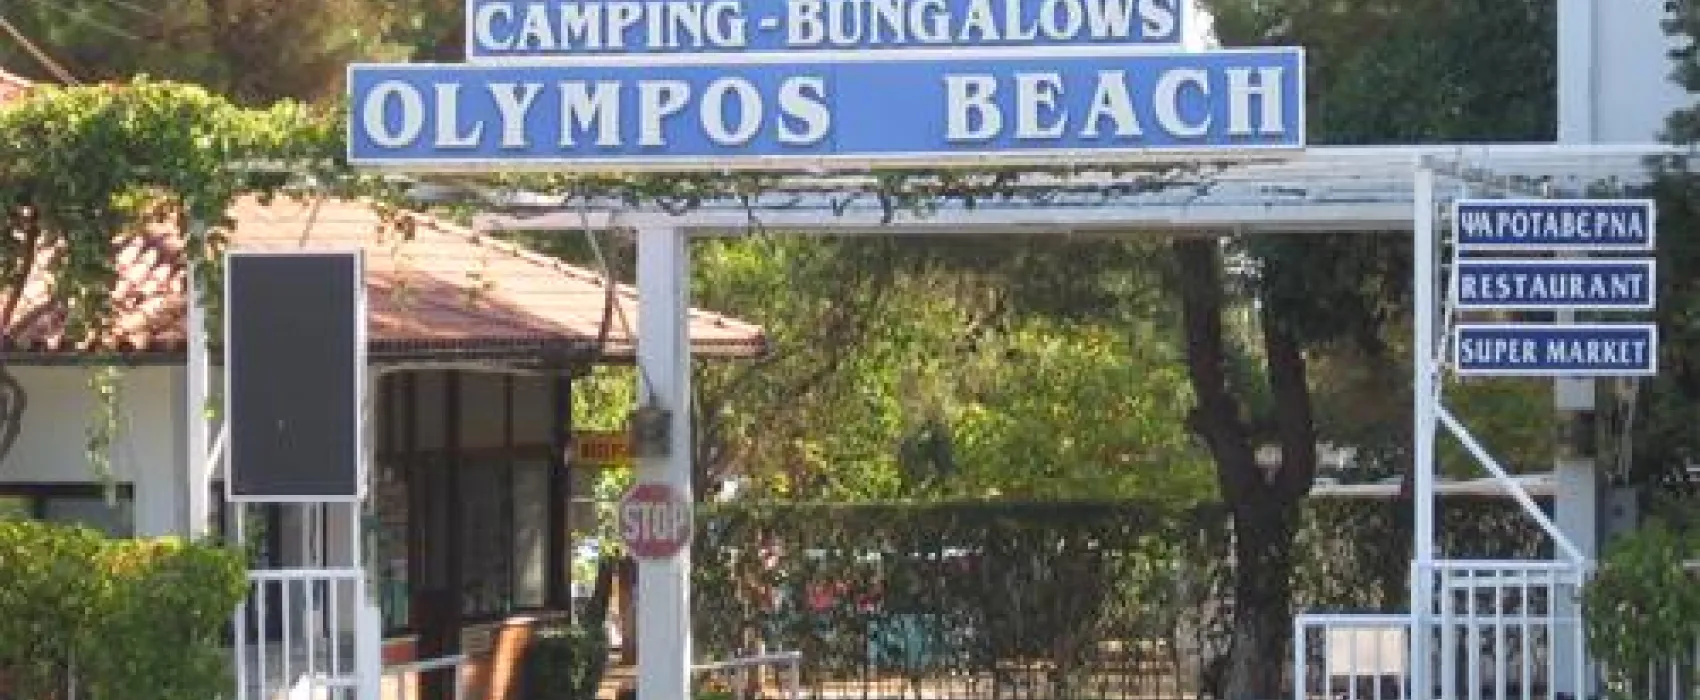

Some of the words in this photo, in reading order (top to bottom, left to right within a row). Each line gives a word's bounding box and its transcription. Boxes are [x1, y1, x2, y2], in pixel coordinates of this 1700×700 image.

[475, 1, 747, 51] CAMPING
[362, 76, 832, 149] OLYMPOS
[945, 66, 1286, 141] BEACH
[1461, 273, 1642, 299] RESTAURANT
[1461, 338, 1537, 364] SUPER
[1546, 338, 1646, 364] MARKET
[624, 501, 690, 541] STOP
